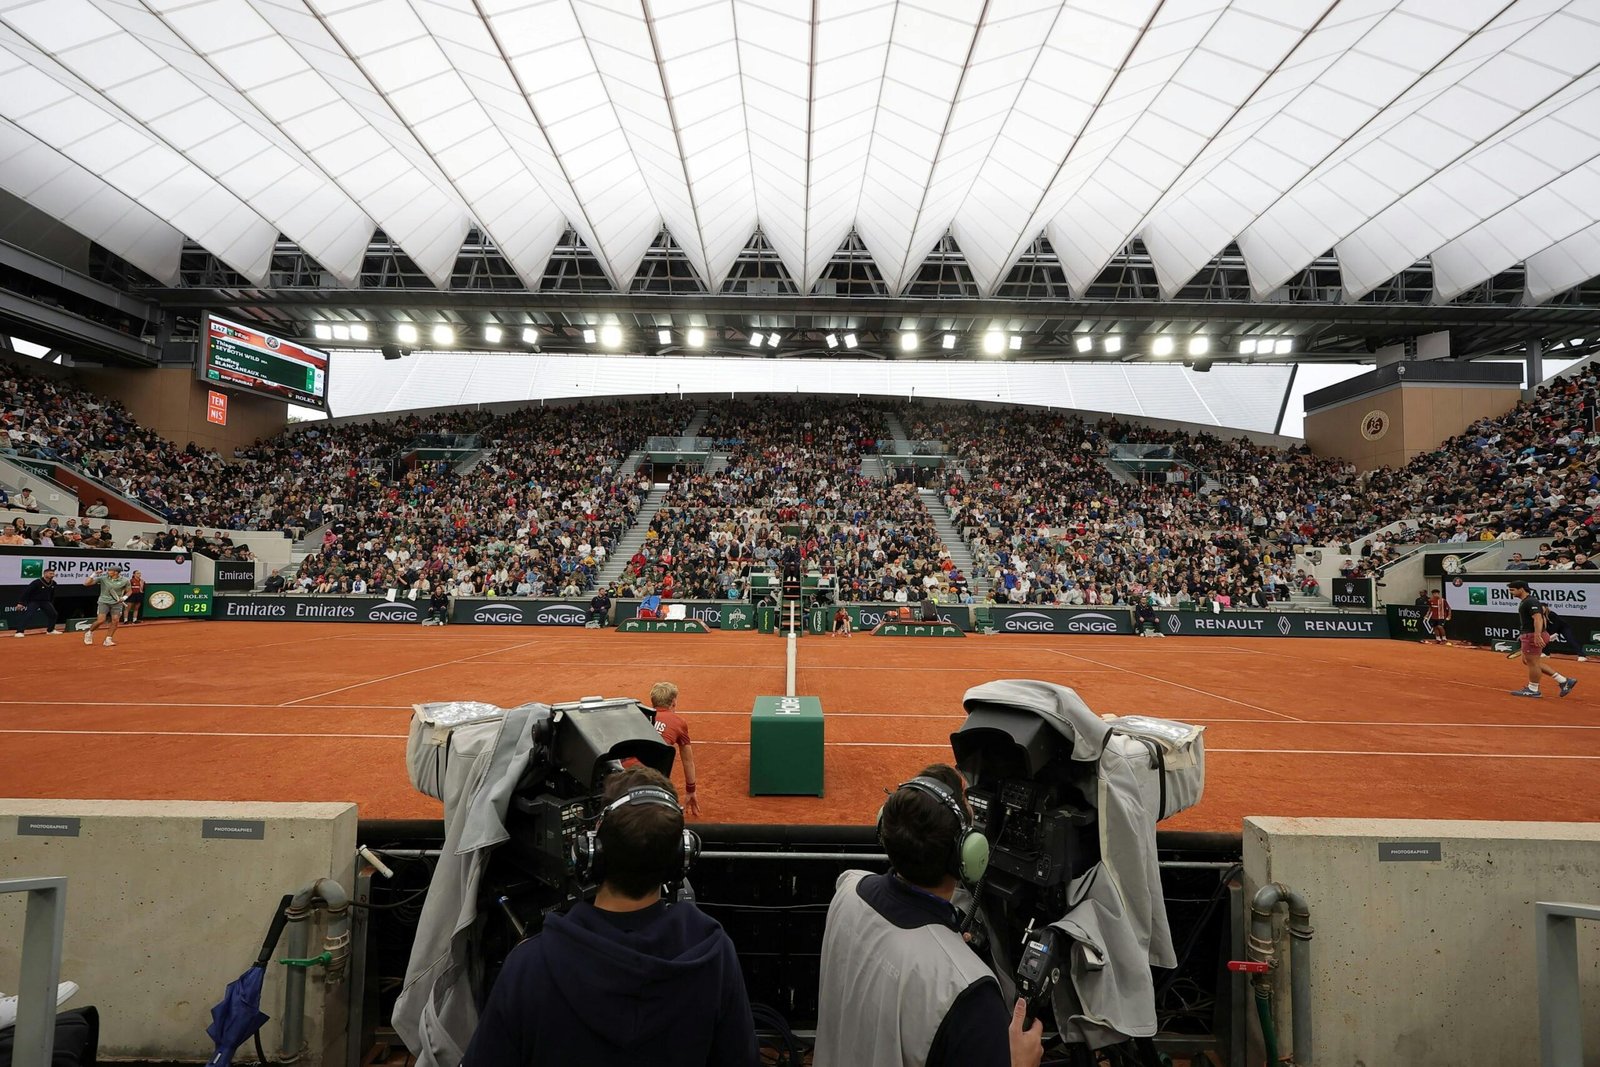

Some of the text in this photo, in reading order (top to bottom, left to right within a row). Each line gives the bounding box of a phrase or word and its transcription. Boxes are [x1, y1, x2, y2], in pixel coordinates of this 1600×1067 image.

[216, 340, 236, 350] Thiago
[216, 345, 243, 357] SEYBOTH
[244, 353, 260, 362] WILD
[215, 355, 240, 366] Geoffrey
[215, 360, 259, 376] BLANCANEAUX
[212, 396, 224, 406] TEN
[296, 395, 316, 404] ROLEX
[211, 410, 222, 420] NIS
[48, 561, 76, 572] BNP
[219, 571, 254, 580] Emirates
[1334, 595, 1366, 604] ROLEX
[1531, 590, 1586, 602] ARIBAS
[184, 604, 206, 612] 0:29
[226, 602, 286, 616] Emirates
[296, 603, 354, 617] Emirates
[1398, 608, 1420, 618] Infosys
[1195, 619, 1373, 632] RENAULT RENAULT
[1402, 619, 1418, 628] 147
[1485, 627, 1509, 638] BNP
